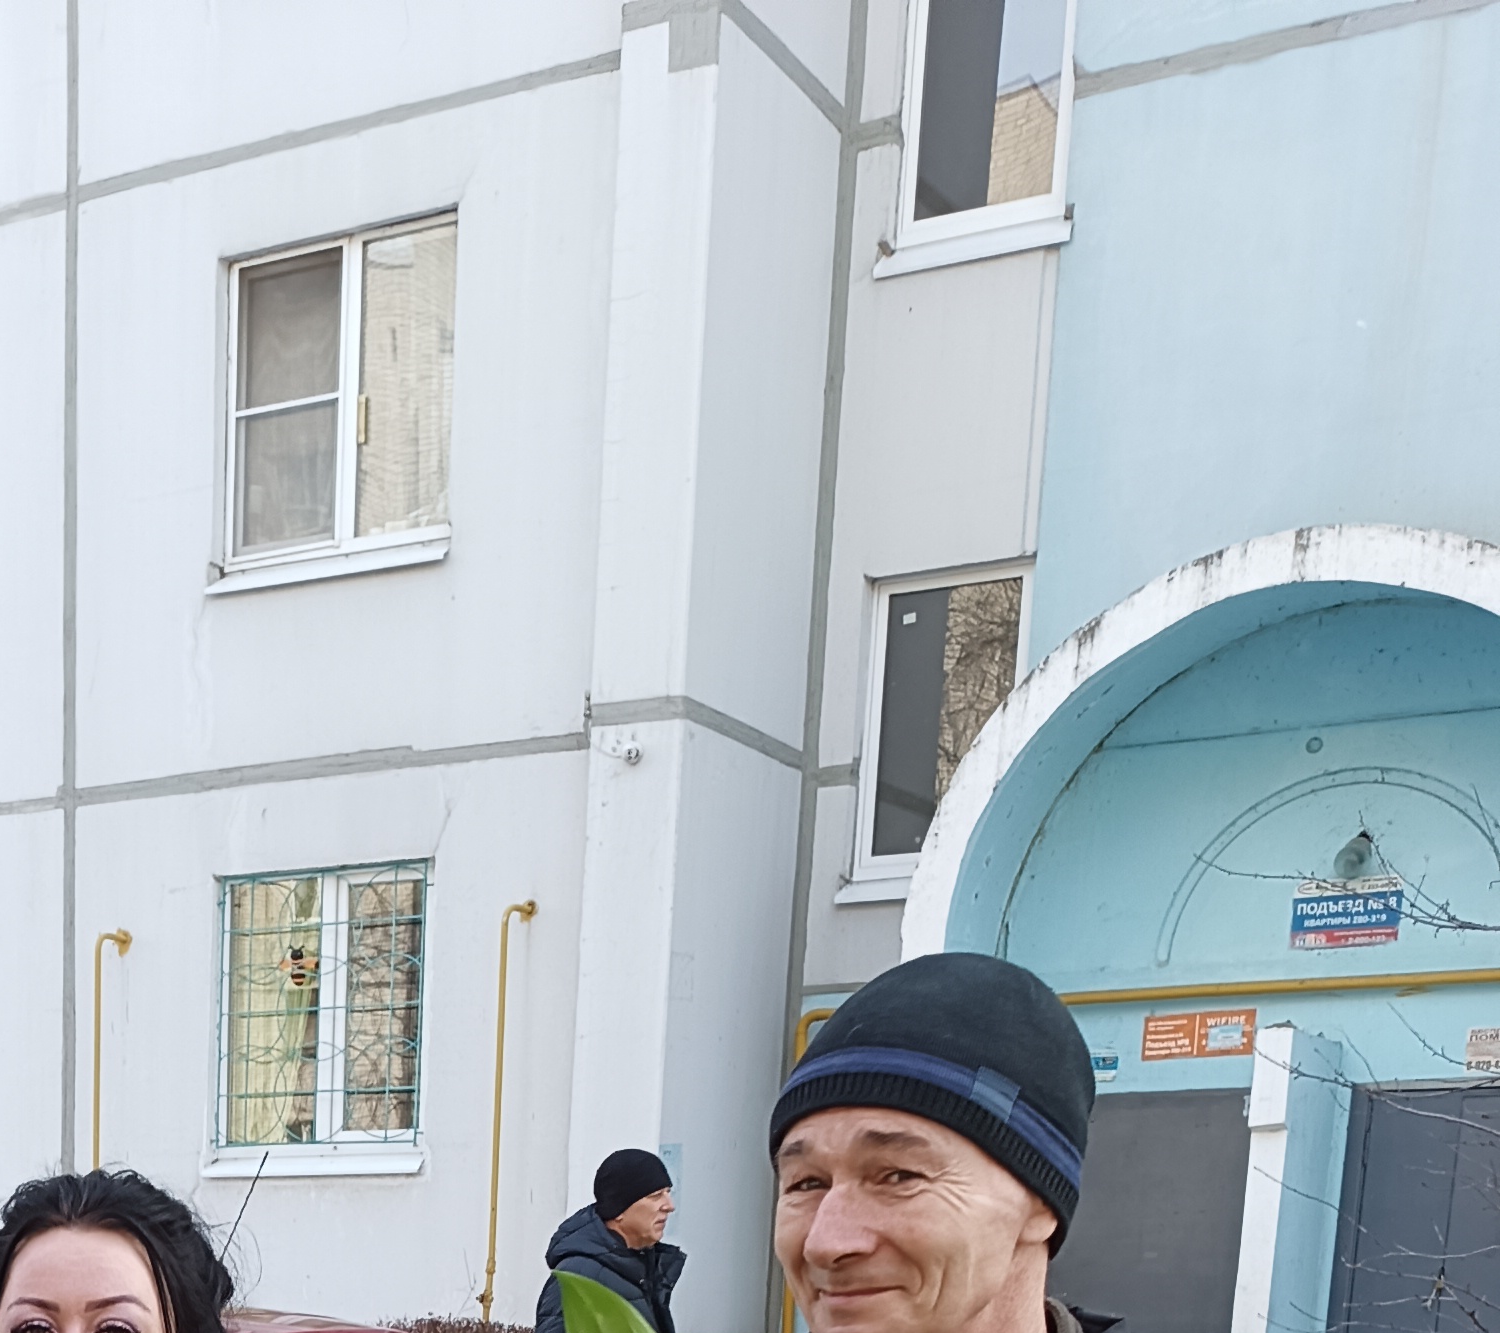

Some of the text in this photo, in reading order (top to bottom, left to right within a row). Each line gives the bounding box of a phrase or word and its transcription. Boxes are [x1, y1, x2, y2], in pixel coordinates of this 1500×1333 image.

[1296, 898, 1364, 916] ПОДЪЕЗД
[1388, 895, 1398, 908] 8
[1303, 913, 1387, 928] КВАРТИРЫ 280-39
